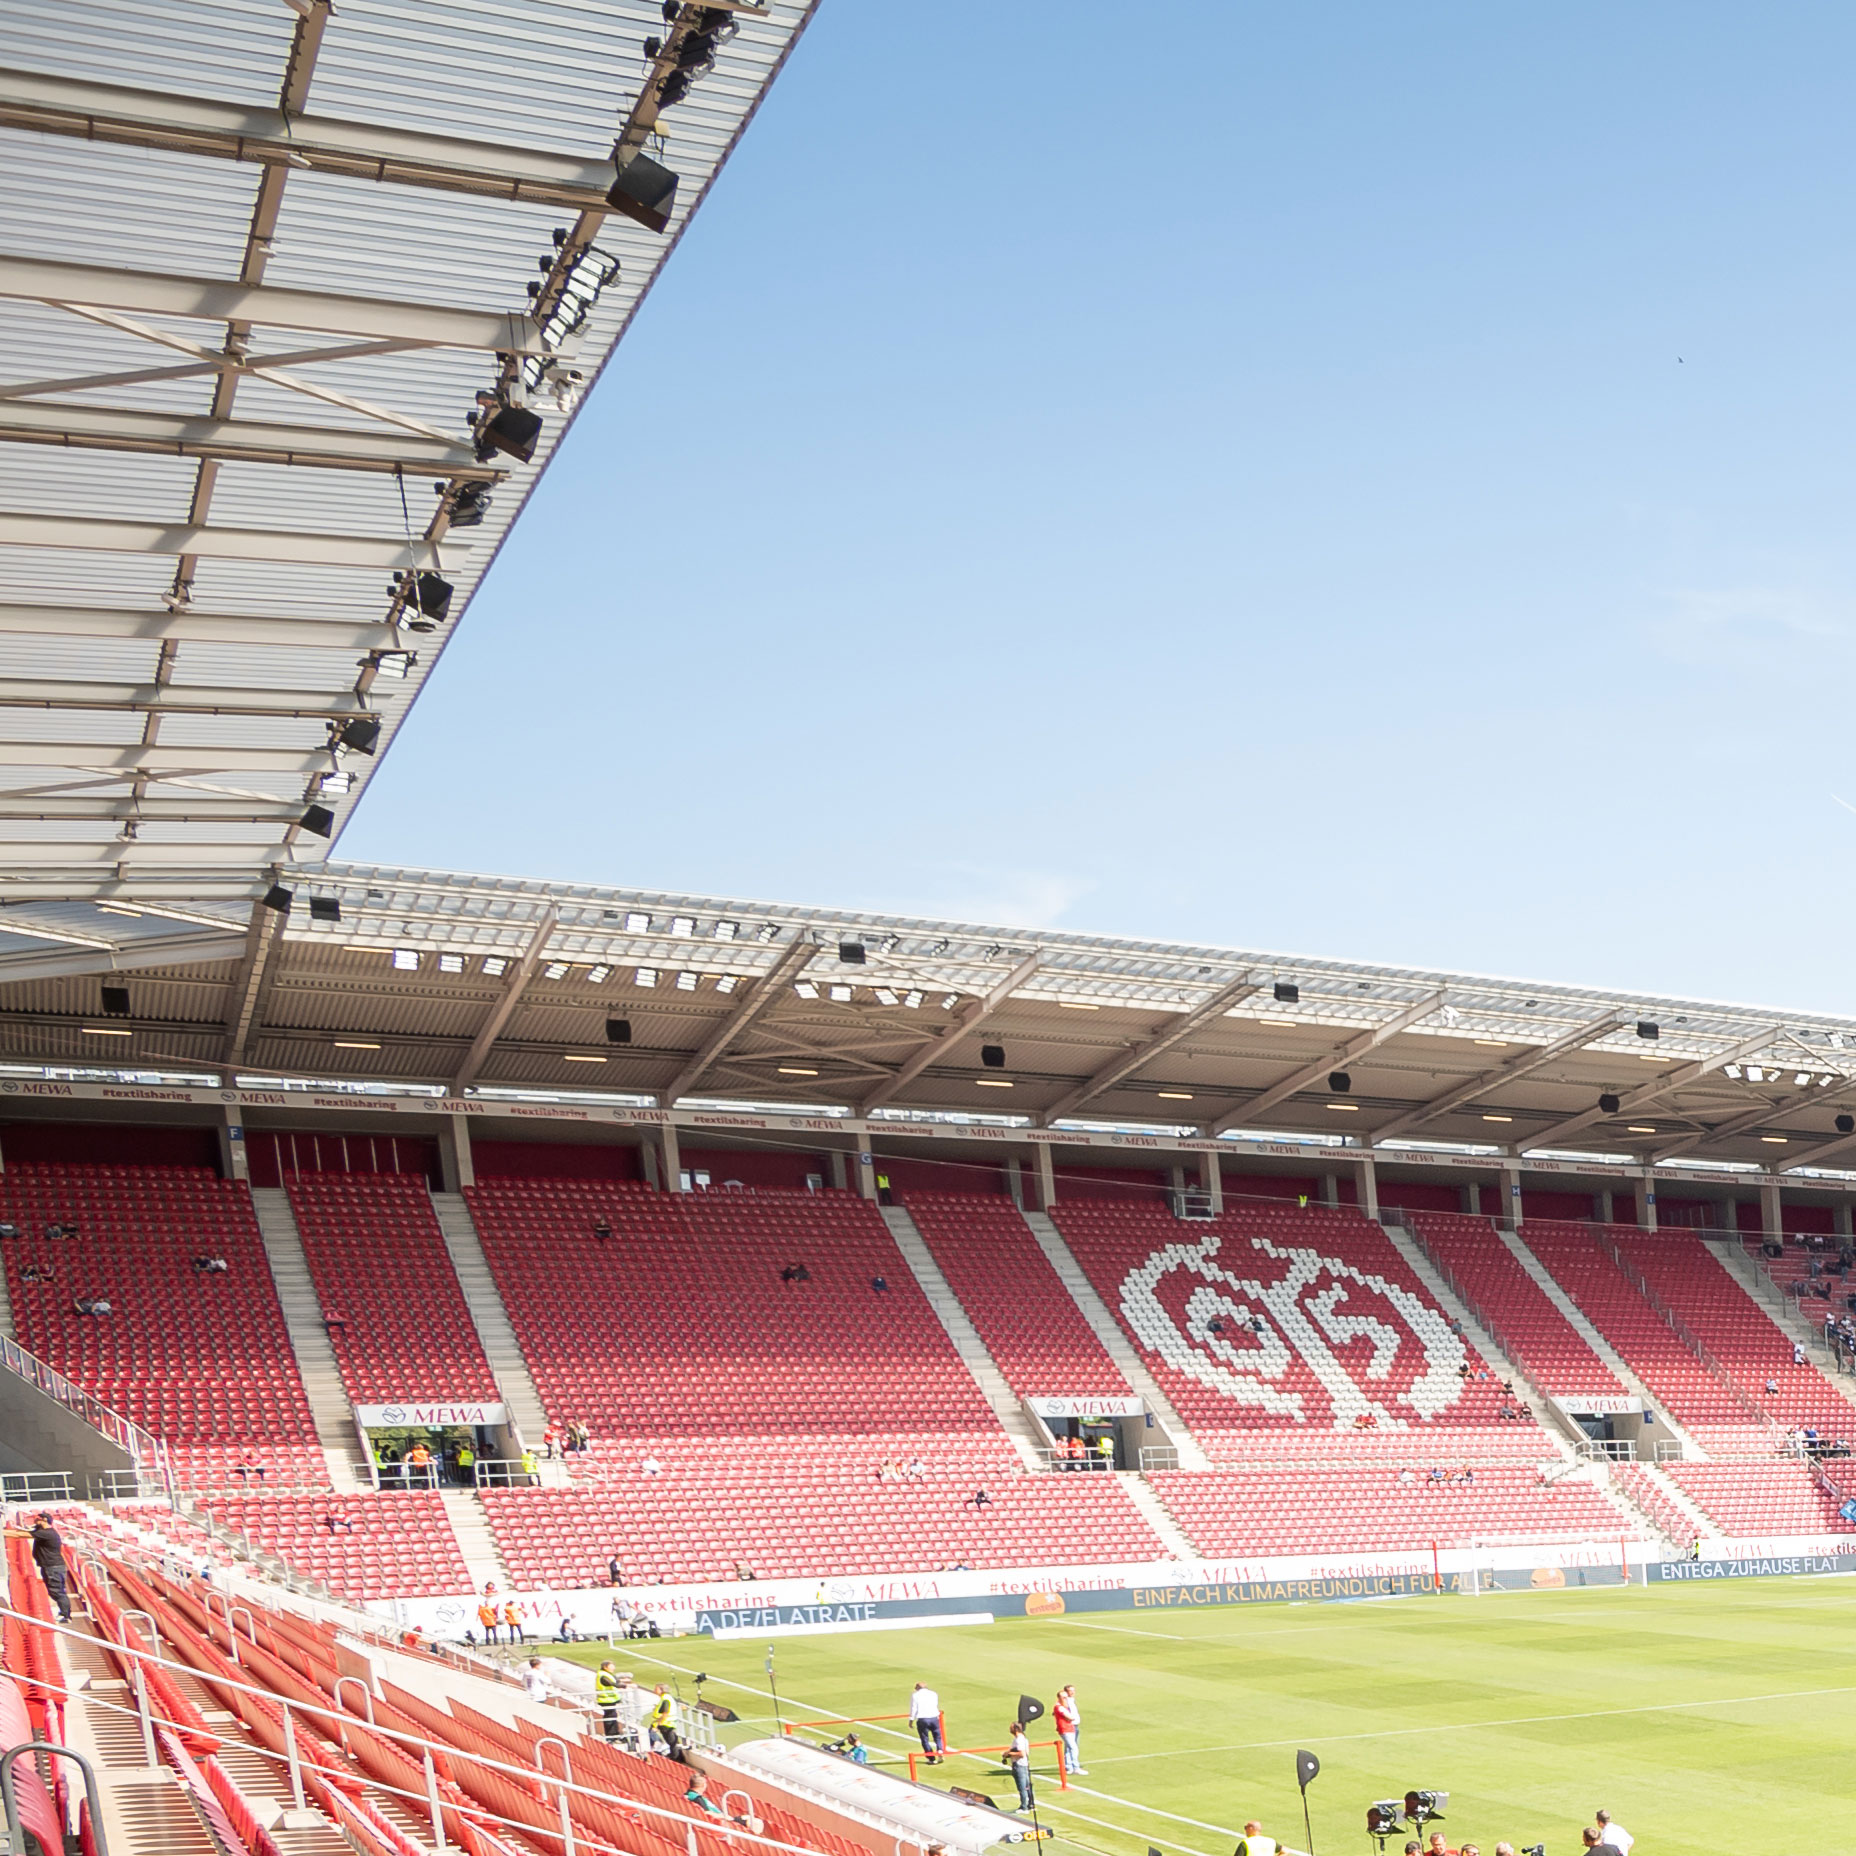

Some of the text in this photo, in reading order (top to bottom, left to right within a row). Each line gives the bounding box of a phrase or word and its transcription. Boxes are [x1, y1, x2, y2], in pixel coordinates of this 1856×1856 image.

[23, 1083, 72, 1095] MEWA
[102, 1088, 192, 1102] #textilsharing
[239, 1092, 286, 1104] MEWA
[313, 1098, 397, 1110] #textilsharing
[441, 1101, 485, 1112] MEWA
[510, 1107, 588, 1119] #textilsharing
[629, 1110, 669, 1121] MEWA
[693, 1115, 766, 1128] #textilsharing
[805, 1119, 842, 1130] MEWA
[865, 1124, 934, 1136] #textilsharing
[970, 1128, 1006, 1138] MEWA
[1026, 1133, 1090, 1144] #textilsharing
[1124, 1137, 1158, 1147] MEWA
[1177, 1141, 1237, 1152] #textilsharing
[1269, 1145, 1300, 1155] MEWA
[1404, 1154, 1435, 1163] MEWA
[1071, 1401, 1127, 1414] MEWA
[1585, 1400, 1629, 1411] MEWA
[414, 1408, 486, 1423] MEWA
[1725, 1544, 1776, 1558] MEWA
[1202, 1561, 1429, 1584] MEWA #textilsharing
[1661, 1556, 1839, 1580] ENTEGA ZUHAUSE FLAT
[864, 1575, 1126, 1601] MEWA #textilsharing
[1133, 1586, 1221, 1607] EINFACH
[1226, 1573, 1405, 1602] KLIMAFREUNDLICH
